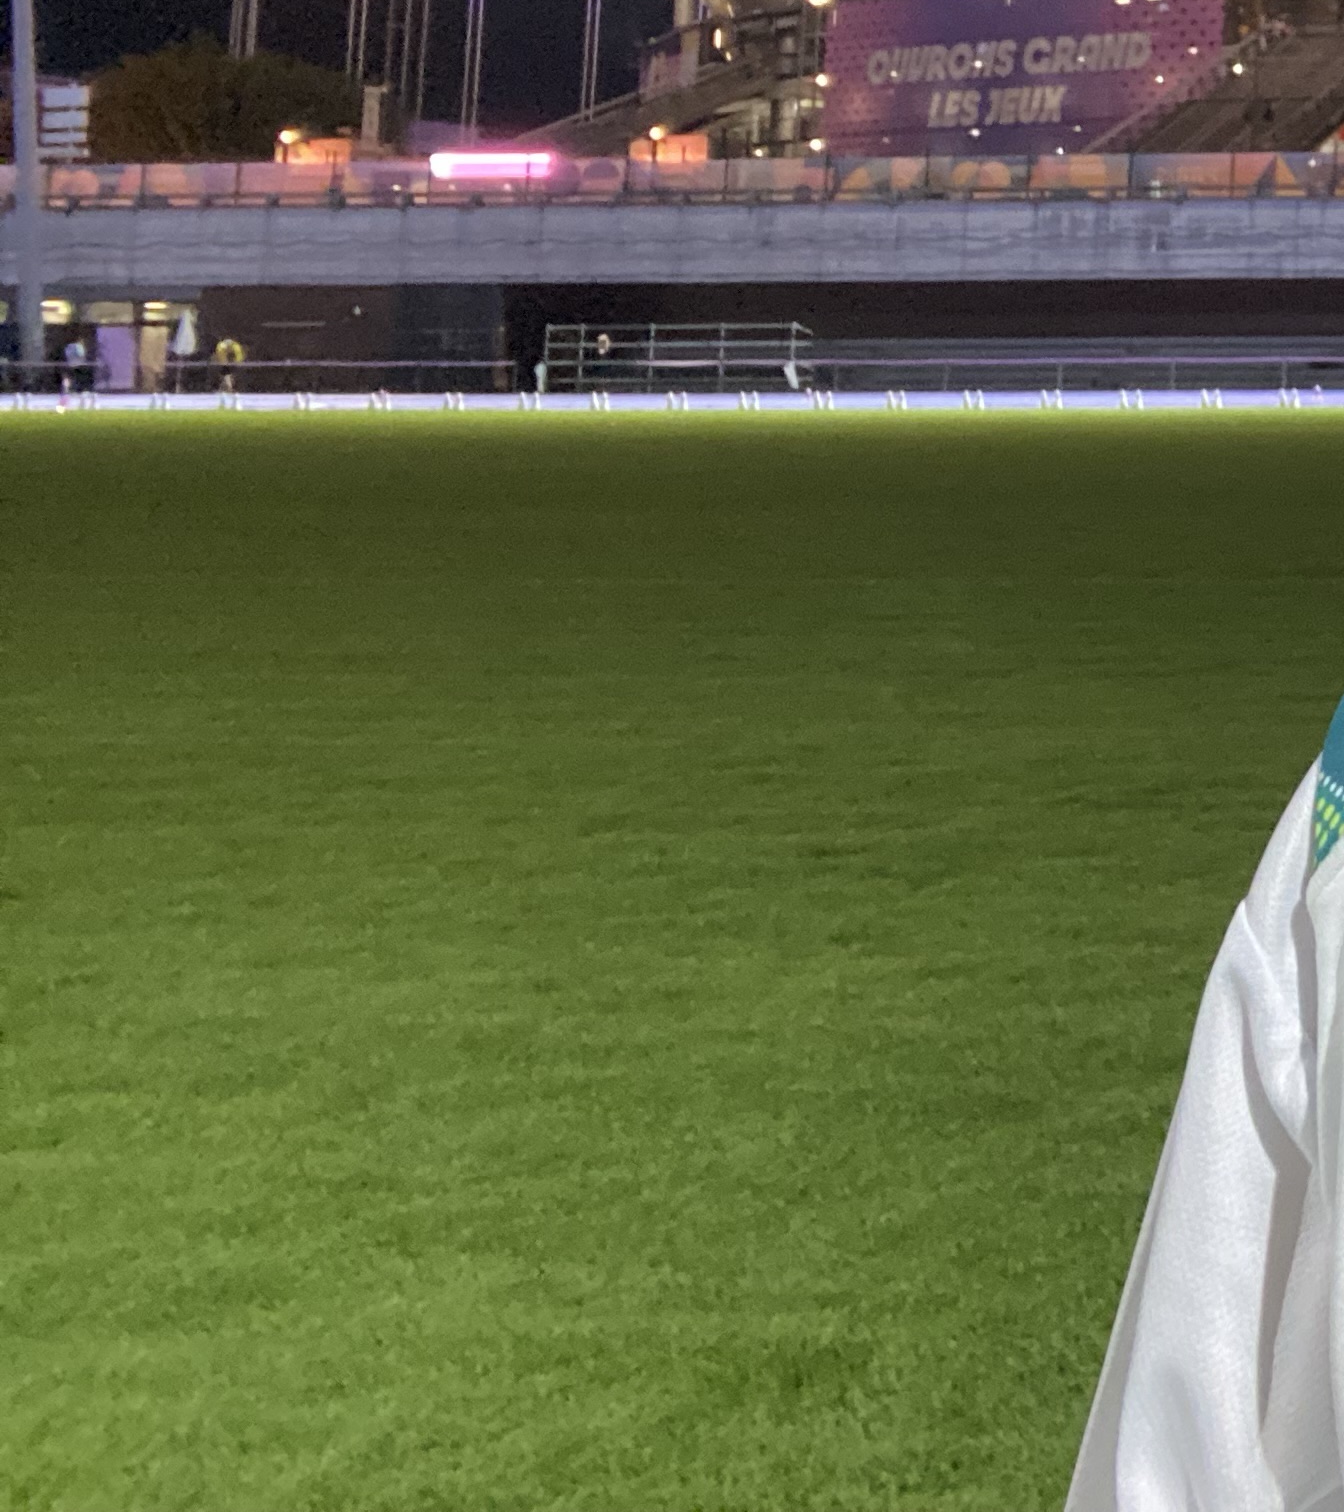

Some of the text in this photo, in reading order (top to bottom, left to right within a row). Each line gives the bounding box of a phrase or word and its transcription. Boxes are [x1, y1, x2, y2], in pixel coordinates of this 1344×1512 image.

[867, 31, 1151, 85] OUVRONS GRAND
[927, 85, 1068, 128] LES JEUX
